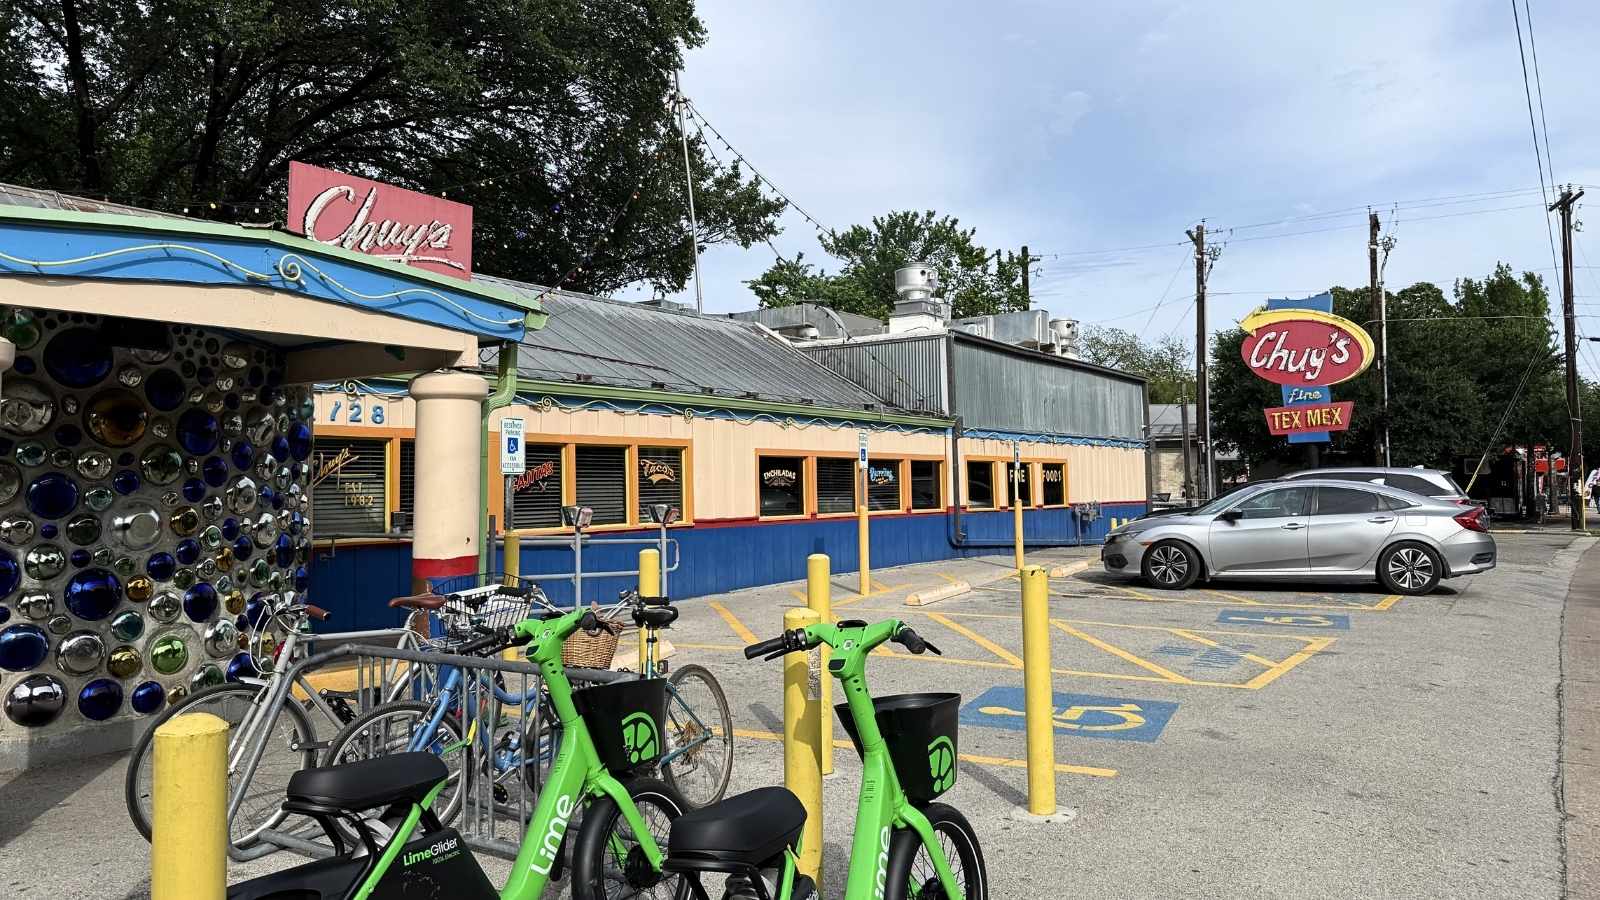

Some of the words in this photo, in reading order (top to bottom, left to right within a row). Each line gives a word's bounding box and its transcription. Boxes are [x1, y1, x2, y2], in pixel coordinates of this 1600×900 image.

[304, 185, 454, 263] Chuy's
[1250, 330, 1351, 380] Chuy's
[1272, 410, 1302, 430] TEX
[1307, 407, 1342, 426] MEX
[1009, 469, 1026, 483] FNE
[344, 495, 374, 507] 1982
[403, 838, 458, 866] LimeGlider
[530, 794, 575, 875] Lime
[874, 826, 890, 899] ime
